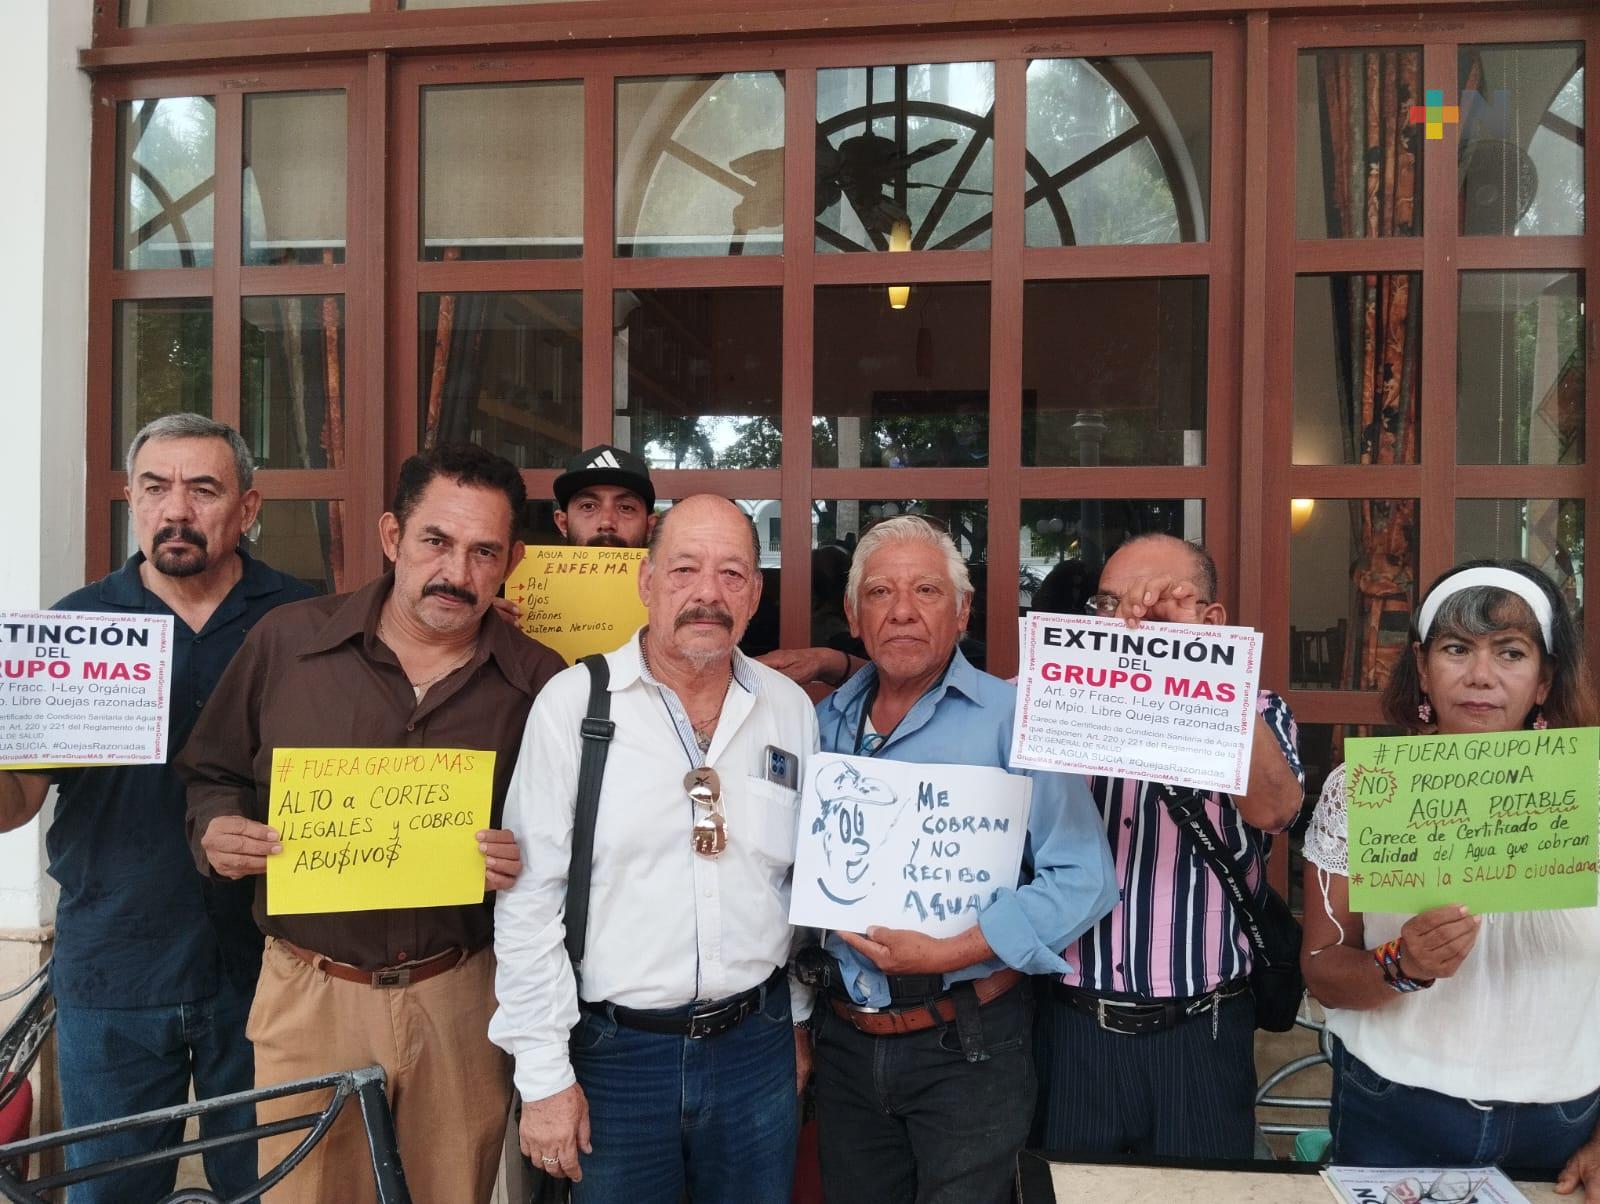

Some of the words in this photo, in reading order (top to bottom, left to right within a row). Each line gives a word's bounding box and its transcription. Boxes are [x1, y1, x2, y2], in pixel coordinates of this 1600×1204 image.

[537, 550, 563, 559] AGUA
[572, 551, 588, 559] NO
[598, 551, 642, 560] POTABLE
[527, 577, 547, 590] Piel
[527, 594, 549, 609] Ojos
[0, 622, 149, 647] TINCIÓN
[1043, 626, 1235, 666] EXTINCIÓN
[35, 646, 71, 658] DEL
[1118, 656, 1152, 672] DEL
[0, 660, 70, 679] UPO
[83, 661, 151, 681] MAS
[1041, 662, 1152, 693] GRUPO
[1164, 676, 1236, 703] MAS
[9, 683, 46, 693] Fracc.
[52, 682, 84, 695] I-Ley
[88, 683, 146, 696] Orgánica
[12, 695, 41, 706] Libre
[46, 695, 90, 708] Quejas
[94, 698, 157, 708] razonadas
[1043, 685, 1064, 697] Art.
[1069, 687, 1085, 699] 97
[1089, 690, 1128, 705] Fracc.
[1168, 700, 1229, 718] Orgánica
[25, 723, 40, 731] 220
[83, 724, 133, 732] Reglamento
[47, 712, 86, 721] Condición
[1030, 714, 1057, 724] Carece
[1033, 698, 1052, 708] del
[1055, 700, 1087, 713] Mpio.
[1091, 704, 1122, 718] Libre
[1125, 709, 1170, 724] Quejas
[1173, 717, 1241, 733] razonadas
[1103, 734, 1119, 743] 220
[1027, 744, 1043, 752] NO
[1045, 746, 1059, 756] AL
[1060, 748, 1089, 760] AGUA
[1359, 776, 1388, 796] NO
[1411, 766, 1534, 792] PROPORCIONA
[278, 789, 333, 816] ALTO
[343, 796, 355, 810] a
[369, 784, 450, 809] CORTES
[917, 781, 950, 812] ME
[1409, 798, 1468, 822] AGUA
[1489, 790, 1577, 814] POTABLE
[279, 817, 374, 842] ILEGALES
[389, 820, 400, 840] y
[409, 811, 474, 831] COBROS
[922, 815, 1010, 834] COBRAN
[1190, 820, 1216, 851] NIKE
[1359, 826, 1417, 846] Carece
[1427, 826, 1446, 842] de
[1456, 816, 1538, 840] Certificado
[1551, 814, 1569, 829] de
[294, 836, 402, 874] ABU$IVO$
[911, 838, 921, 864] Y
[930, 841, 961, 858] NO
[1361, 847, 1418, 864] Calidad
[1433, 843, 1453, 861] del
[1464, 843, 1496, 861] Agua
[1506, 842, 1528, 860] que
[1537, 832, 1589, 851] cobran
[903, 864, 991, 883] RECIBO
[1370, 869, 1425, 888] DAÑAN
[1437, 868, 1452, 886] la
[1463, 864, 1517, 883] SALUD
[1227, 876, 1244, 902] NIKE
[1250, 924, 1265, 949] NIKE
